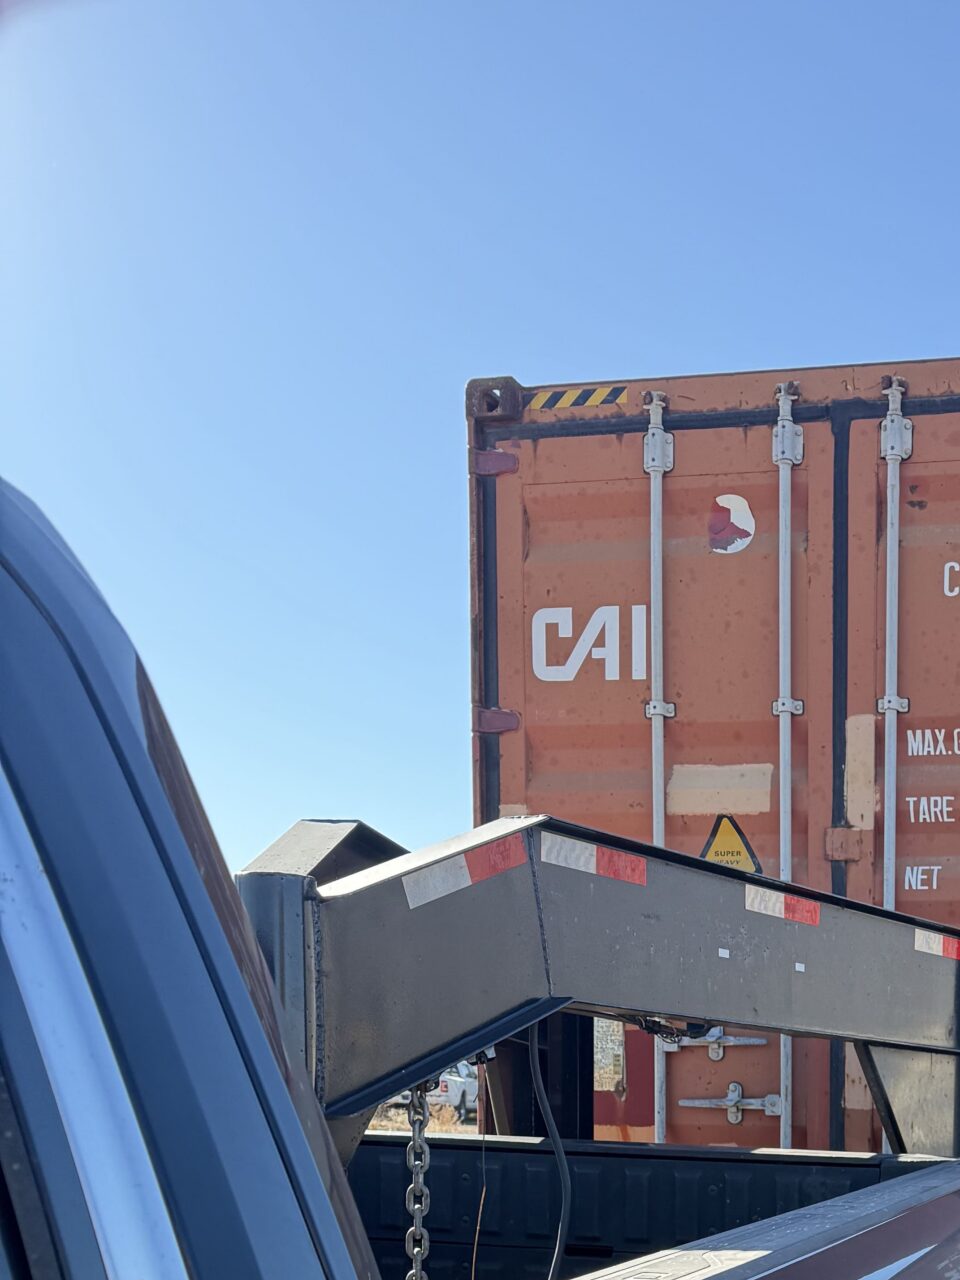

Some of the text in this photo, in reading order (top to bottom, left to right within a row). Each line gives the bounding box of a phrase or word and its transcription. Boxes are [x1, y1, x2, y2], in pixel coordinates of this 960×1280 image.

[532, 604, 647, 682] CAI
[905, 796, 955, 823] TARE
[904, 865, 942, 890] NET
